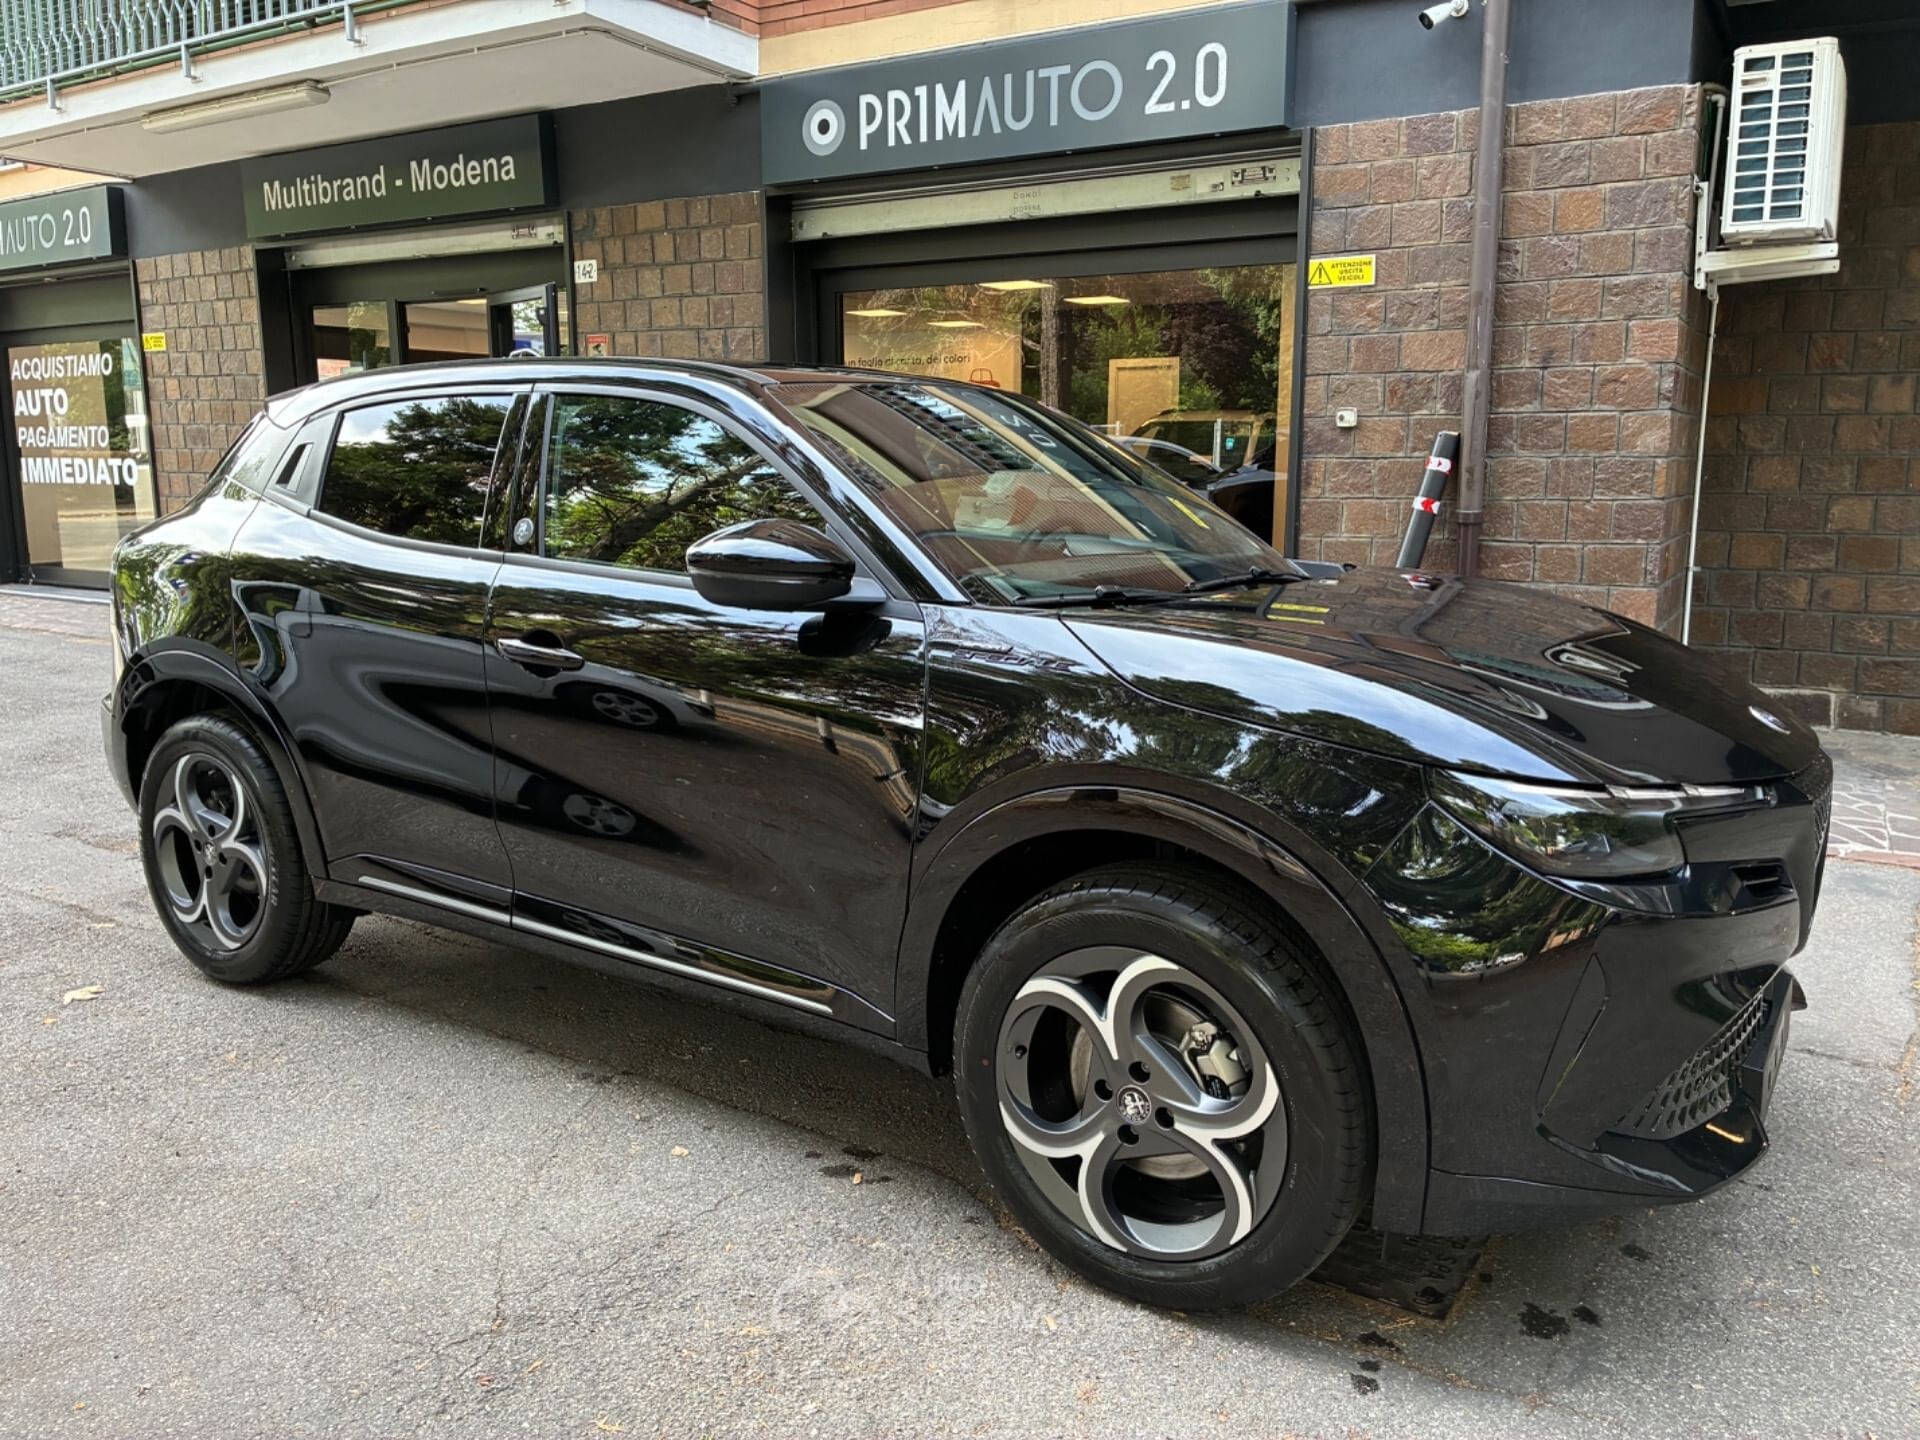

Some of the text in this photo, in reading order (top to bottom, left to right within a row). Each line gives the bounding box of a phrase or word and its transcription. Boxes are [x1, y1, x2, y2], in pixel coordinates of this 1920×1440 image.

[858, 42, 1228, 151] PR1MAUTO 2.0
[262, 153, 516, 212] Multibrand - Modena
[62, 206, 91, 246] 2.0
[577, 263, 594, 280] 142
[1331, 260, 1372, 269] ATTENZIONE
[11, 353, 113, 381] ACQUISTIAMO
[944, 353, 970, 364] colori
[14, 387, 69, 417] AUTO
[18, 426, 110, 448] PAGAMENTO
[20, 457, 138, 487] IMMEDIATO
